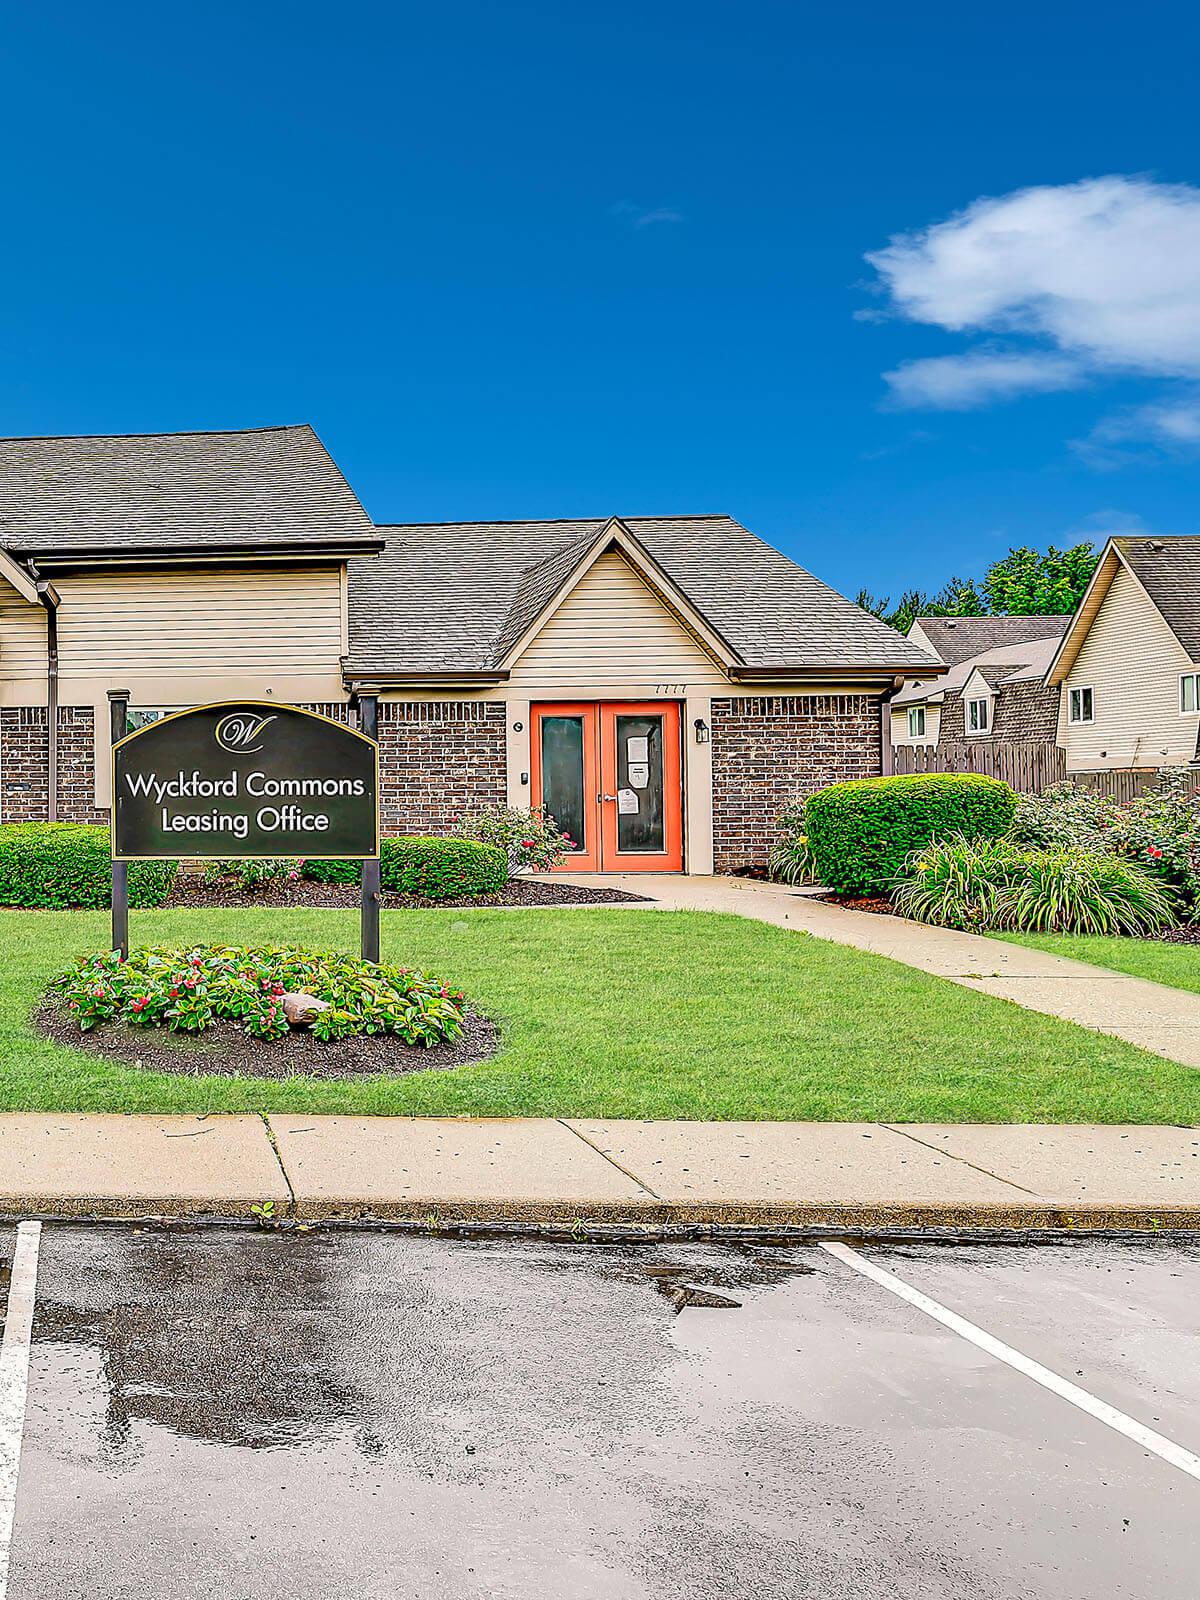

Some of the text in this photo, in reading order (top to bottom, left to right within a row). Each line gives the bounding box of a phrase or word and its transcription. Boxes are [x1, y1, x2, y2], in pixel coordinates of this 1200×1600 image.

[655, 683, 687, 694] 7777
[219, 713, 278, 749] W
[125, 771, 365, 804] Wyckford Commons
[162, 805, 329, 838] Leasing Office
